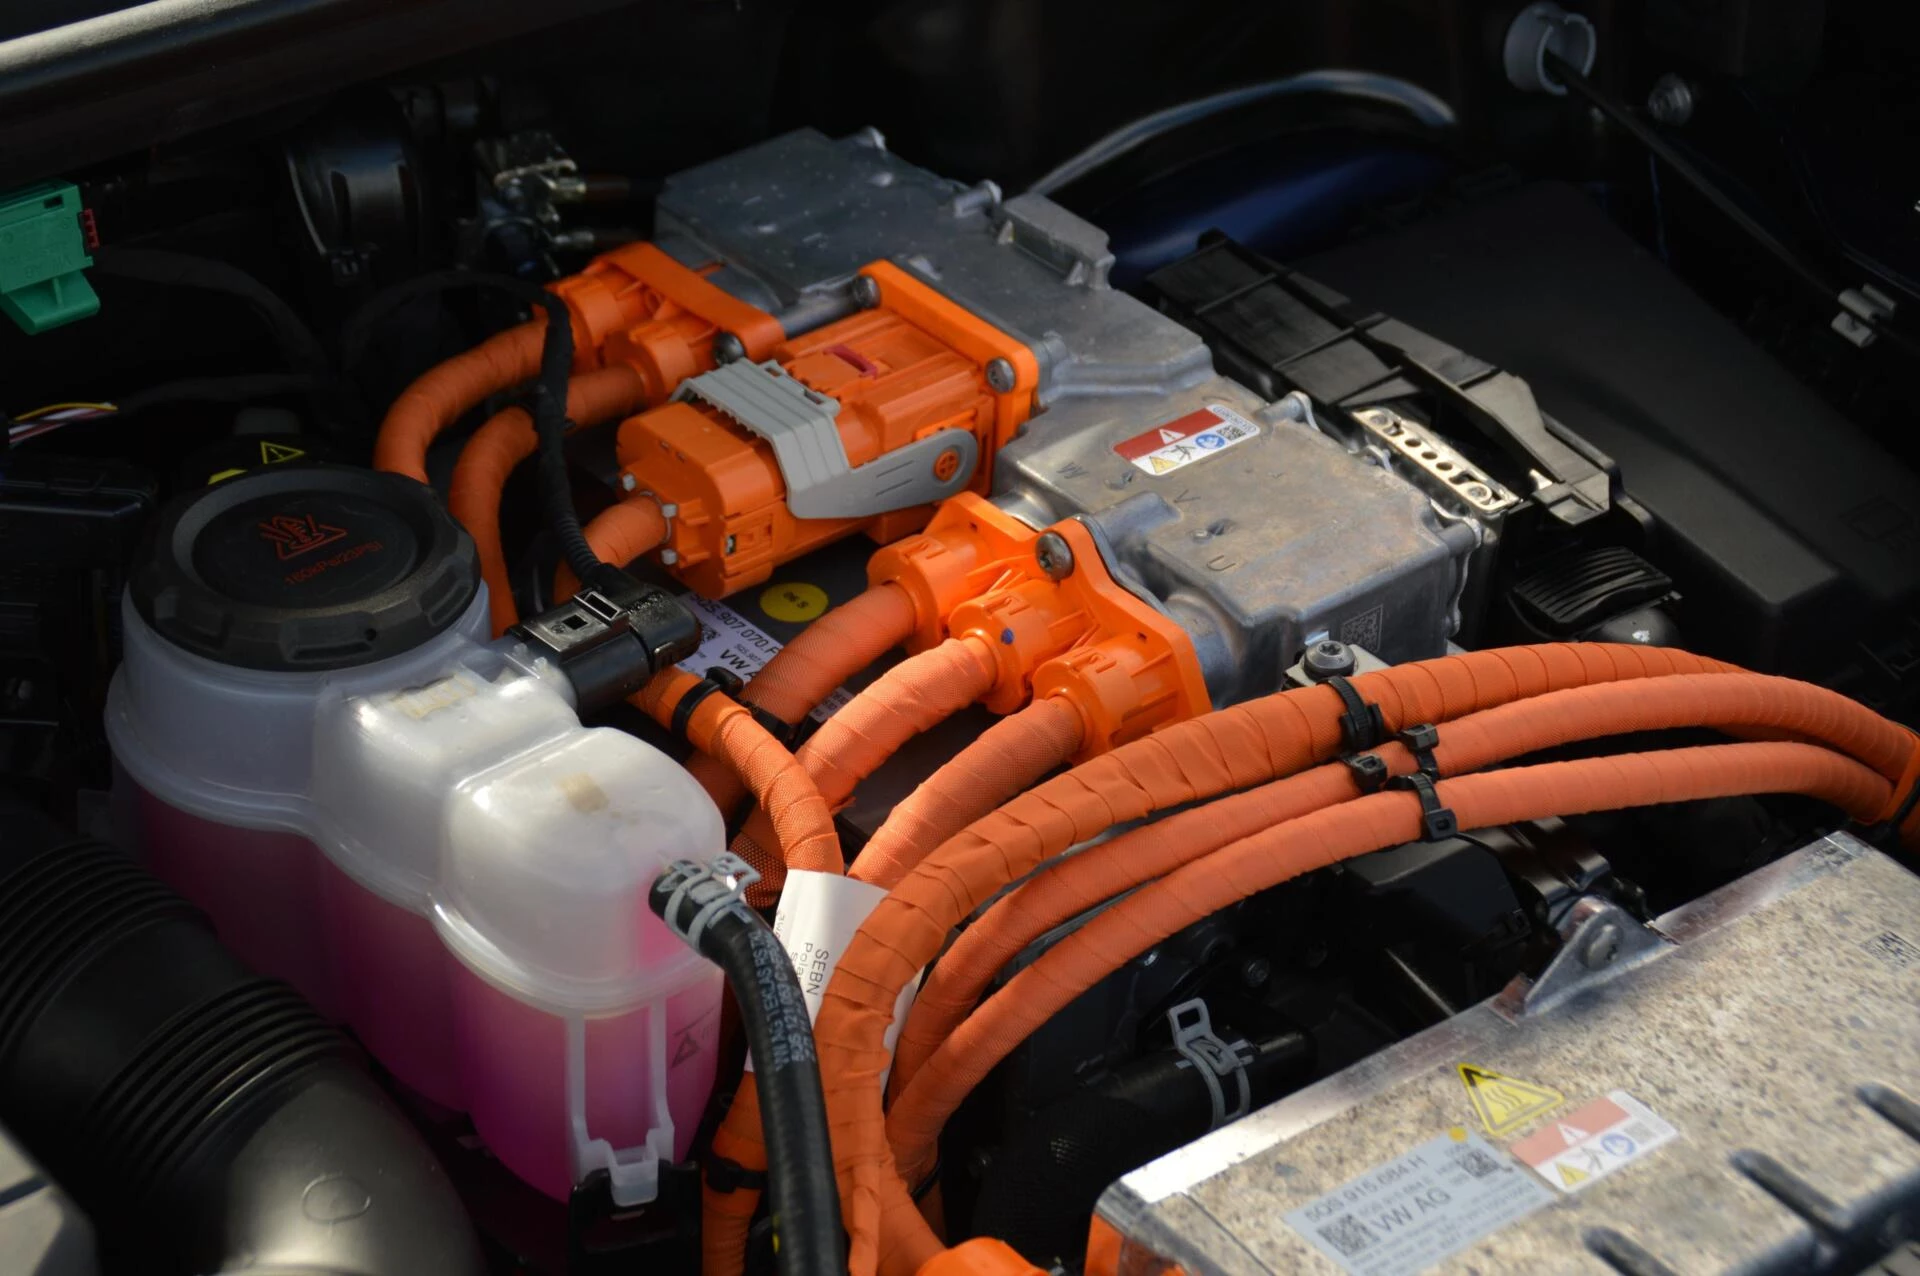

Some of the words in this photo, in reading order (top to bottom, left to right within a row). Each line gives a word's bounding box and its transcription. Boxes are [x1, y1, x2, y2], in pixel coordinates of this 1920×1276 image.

[720, 649, 751, 670] VW
[806, 949, 829, 996] SEBN
[1369, 1206, 1413, 1233] VW
[1414, 1187, 1452, 1214] AG
